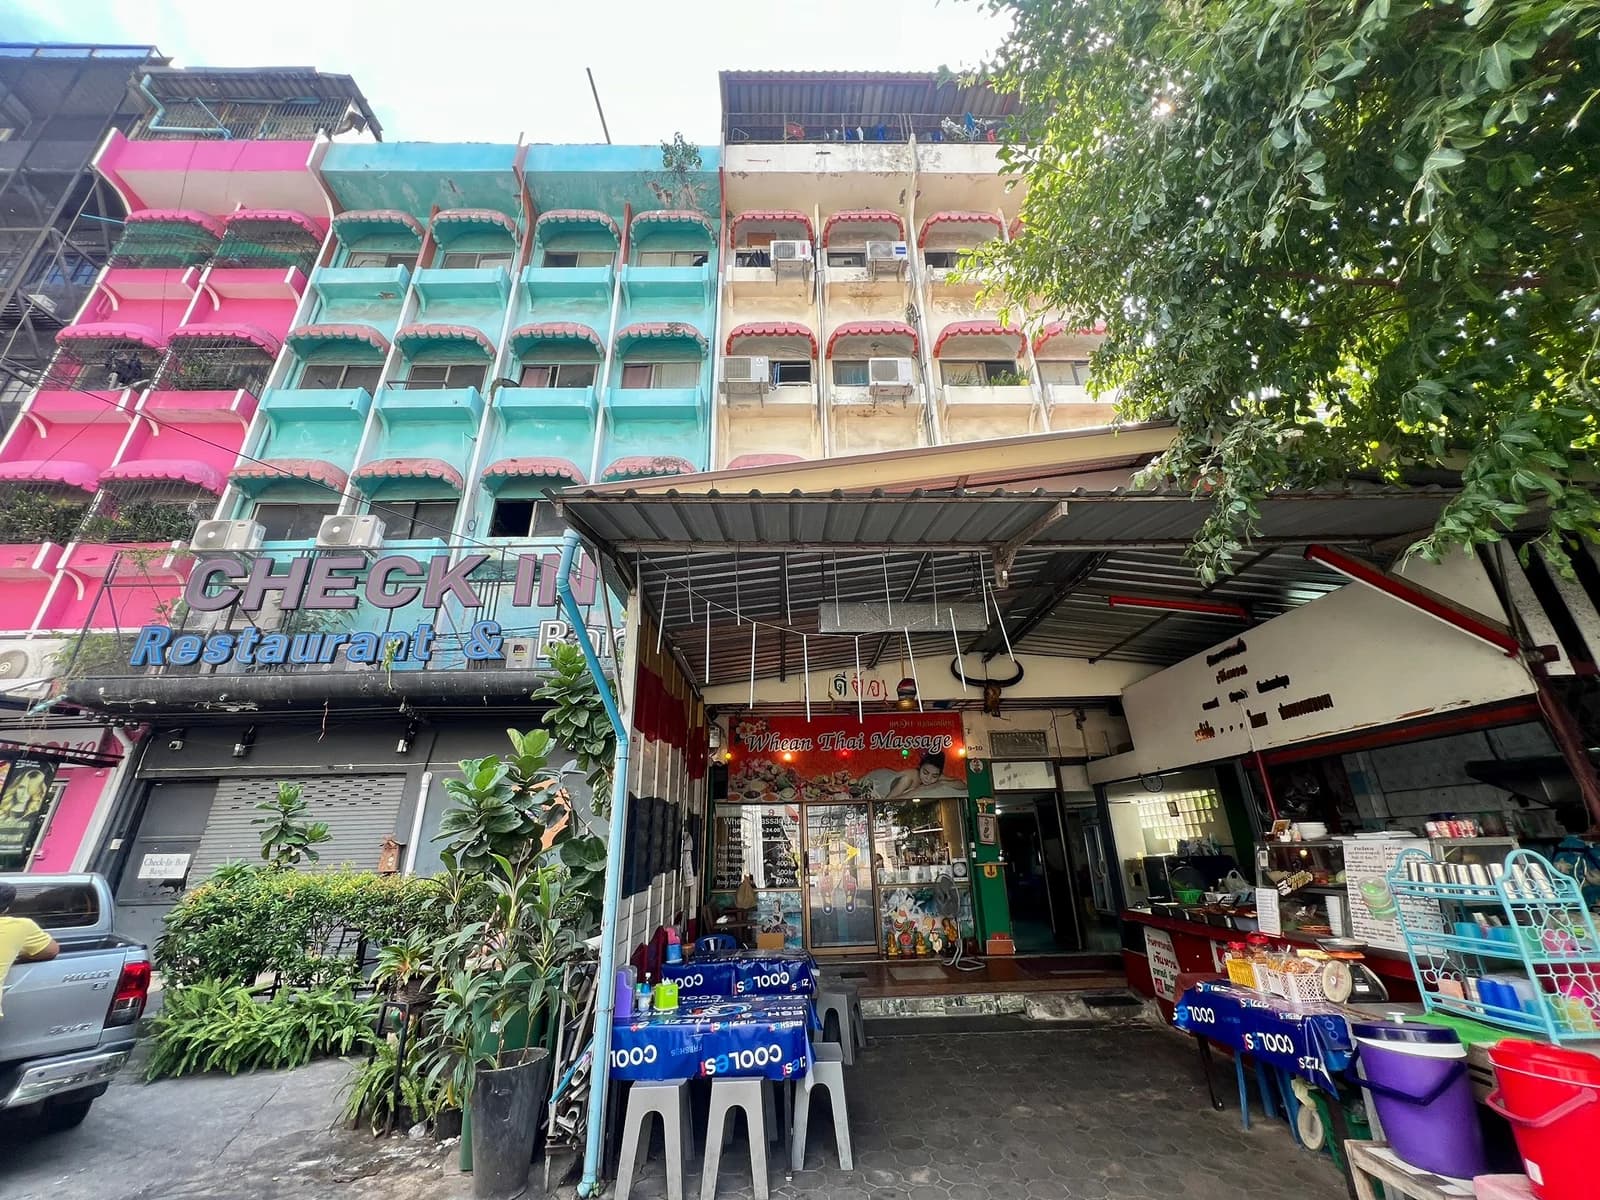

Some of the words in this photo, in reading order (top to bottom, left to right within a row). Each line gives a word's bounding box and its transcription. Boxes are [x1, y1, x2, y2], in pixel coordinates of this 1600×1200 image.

[184, 553, 490, 612] CHECK
[512, 552, 597, 607] IN
[130, 622, 434, 666] Restaurant
[463, 620, 503, 660] &
[744, 730, 813, 752] Whean
[817, 729, 865, 751] Thai
[870, 729, 953, 755] Massage
